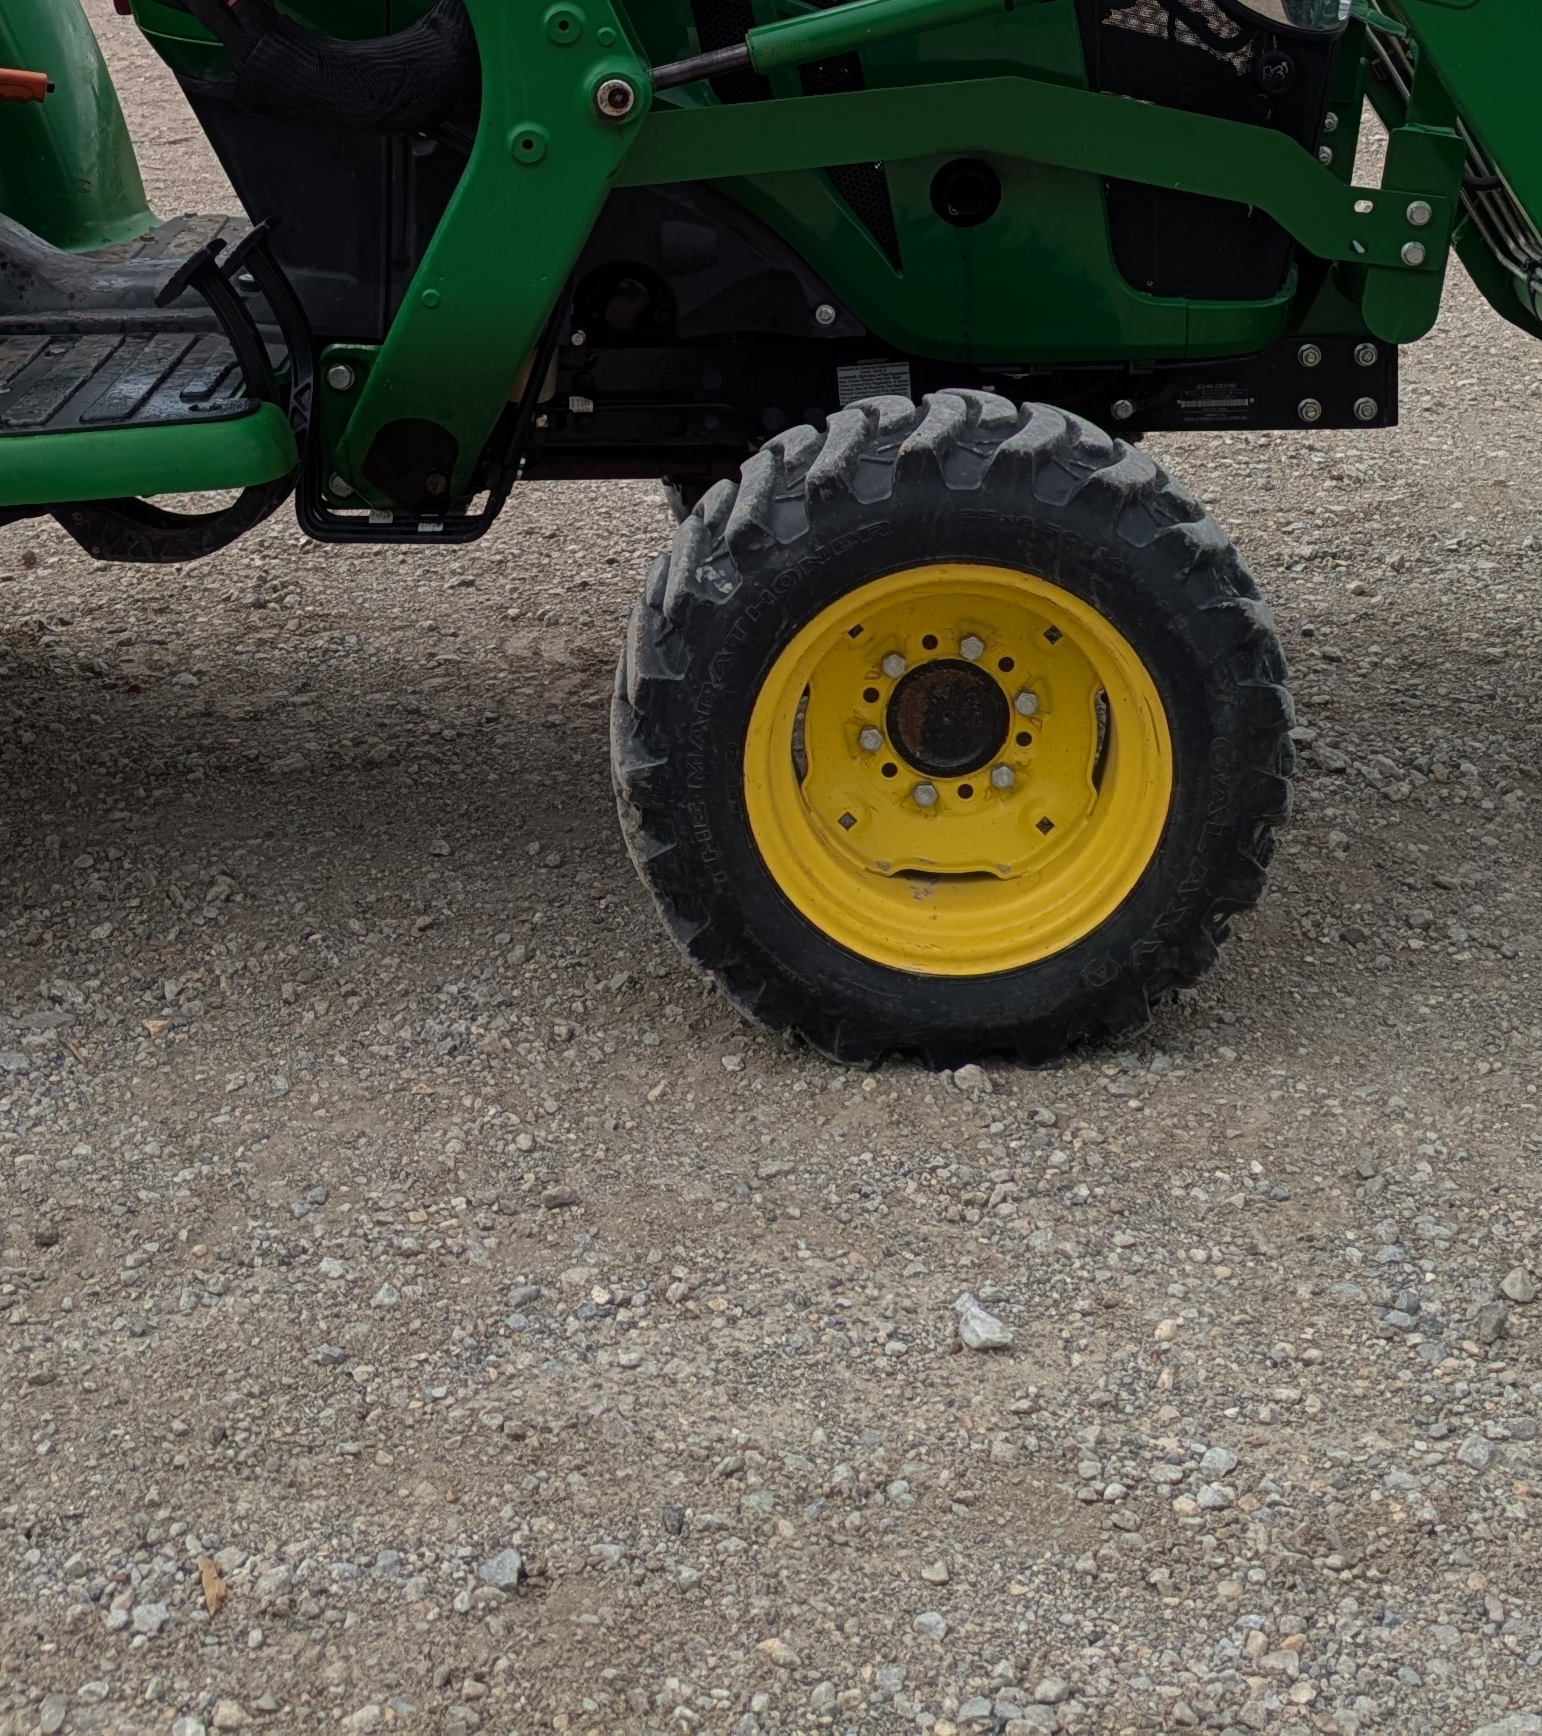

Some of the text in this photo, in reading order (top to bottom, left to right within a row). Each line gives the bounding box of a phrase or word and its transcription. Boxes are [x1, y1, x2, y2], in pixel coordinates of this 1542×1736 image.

[685, 519, 892, 791] MARATHONER
[684, 800, 728, 889] THE
[1130, 736, 1234, 969] GALAXY
